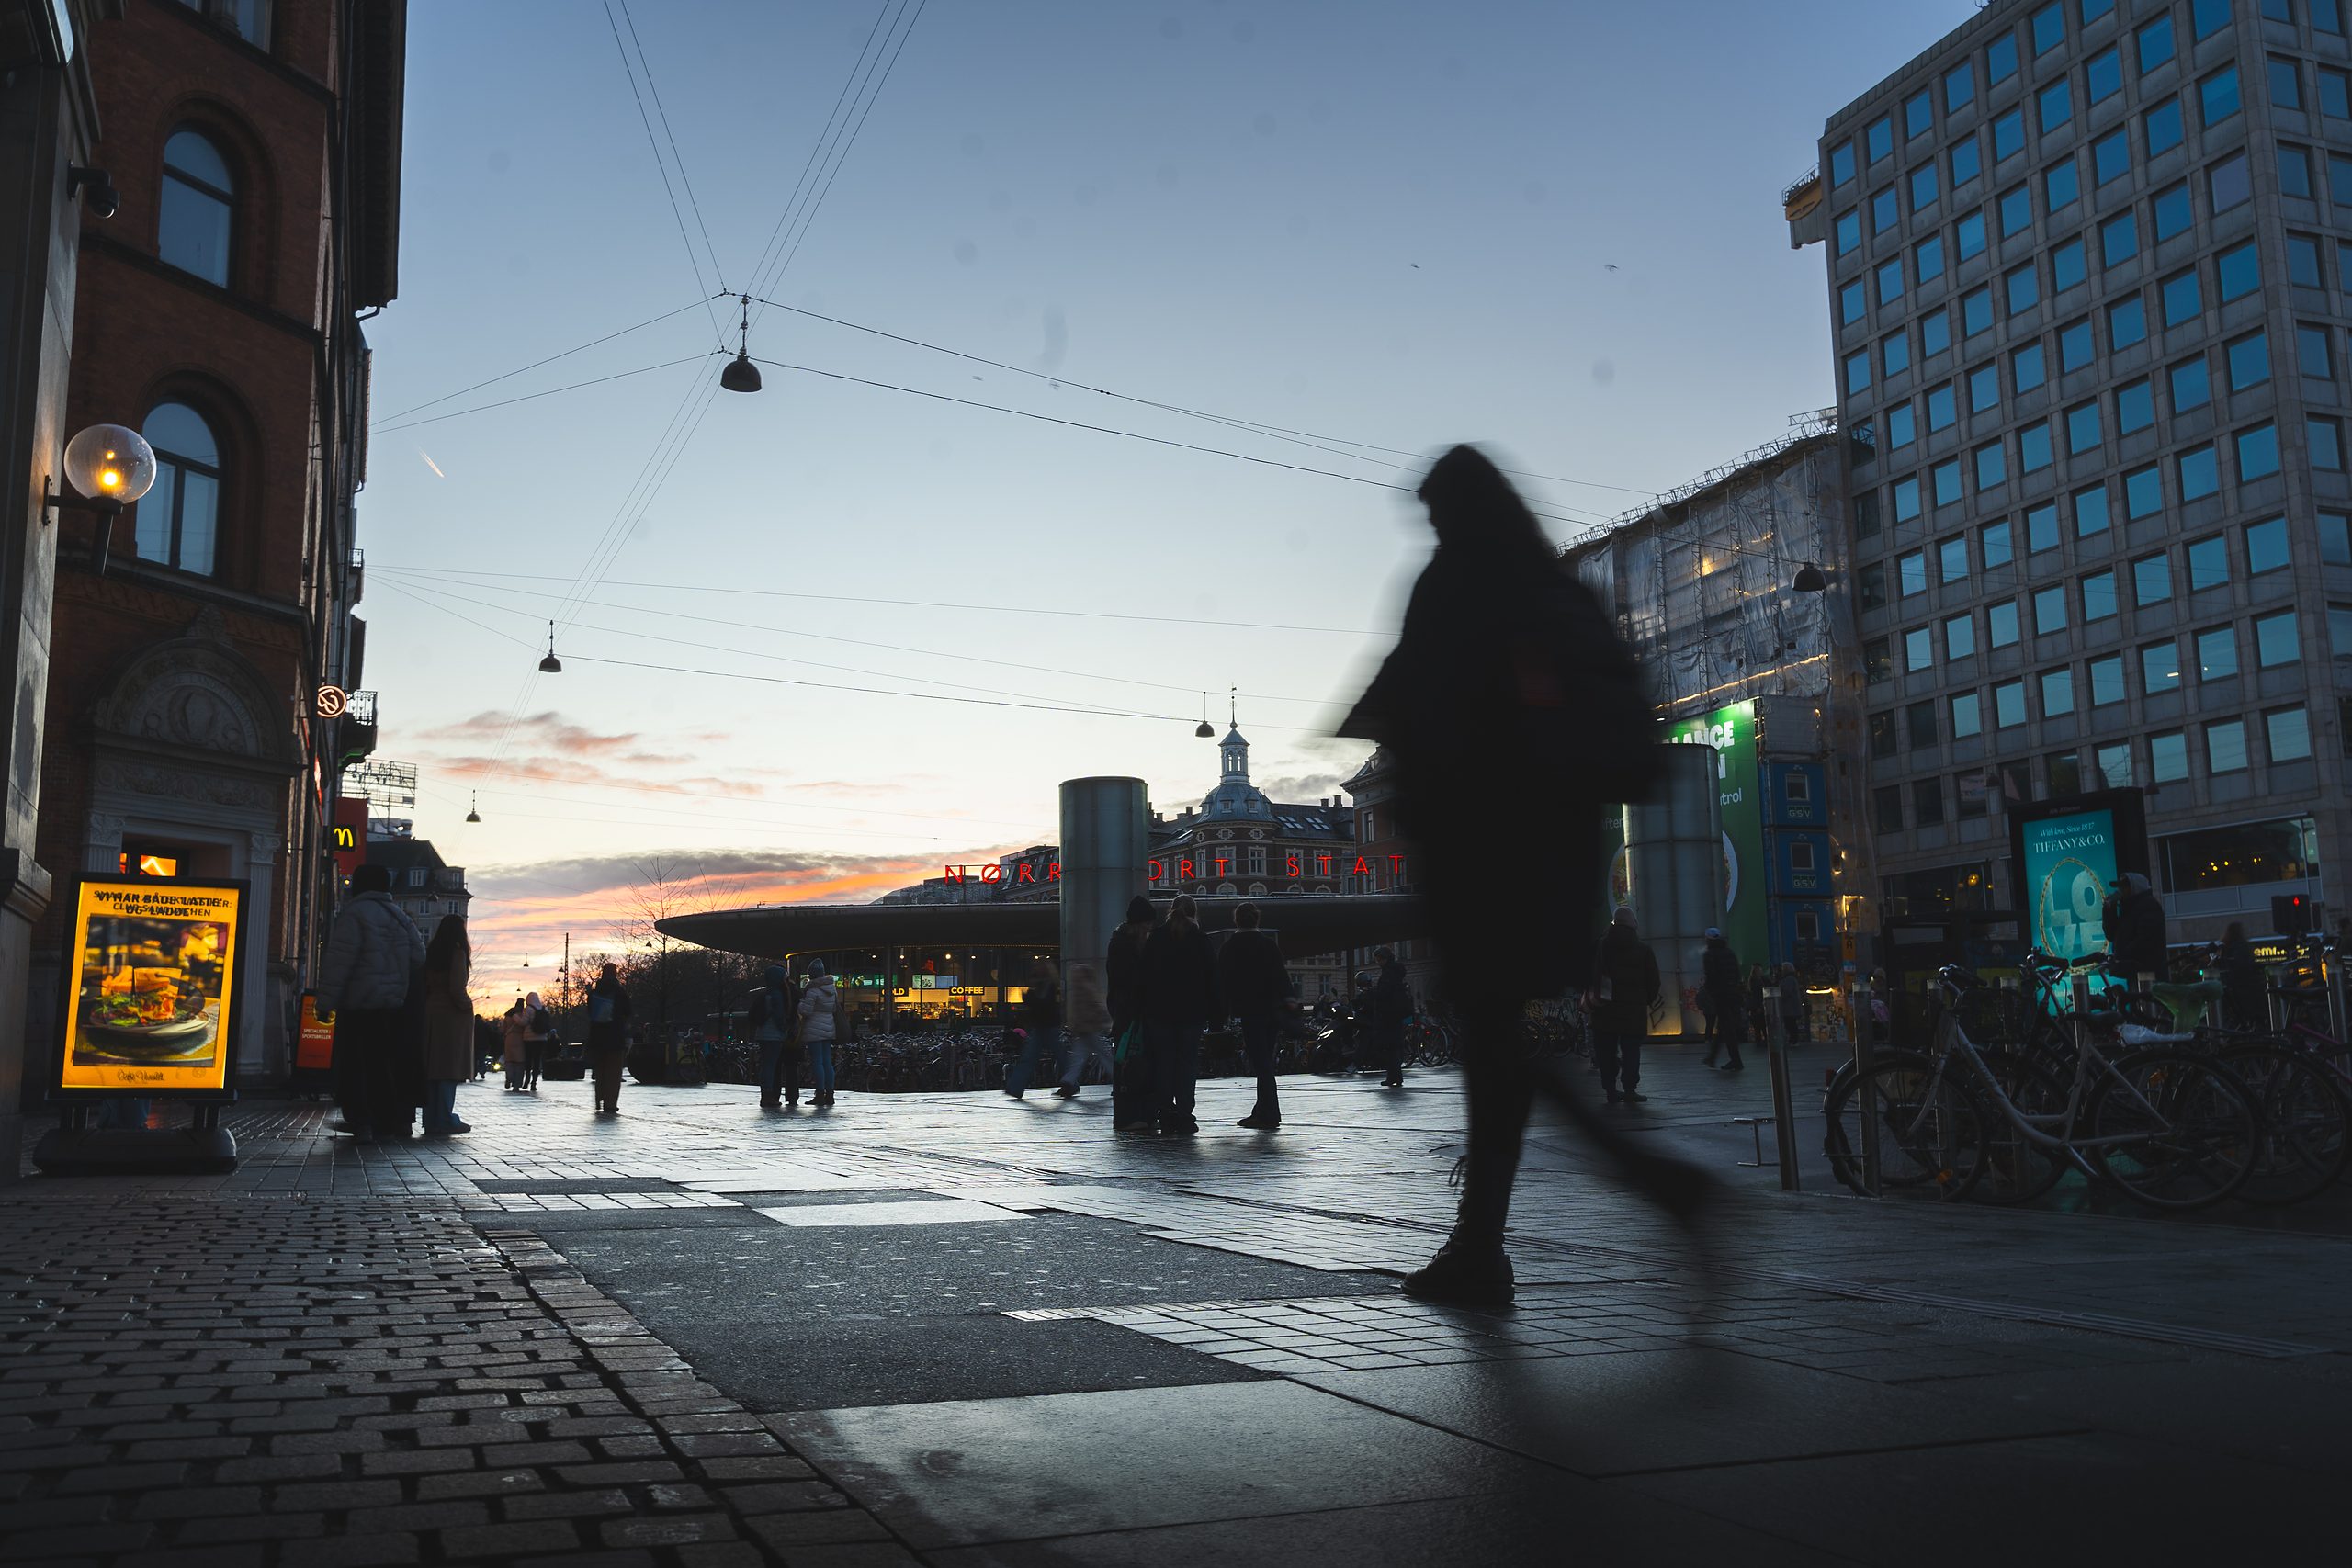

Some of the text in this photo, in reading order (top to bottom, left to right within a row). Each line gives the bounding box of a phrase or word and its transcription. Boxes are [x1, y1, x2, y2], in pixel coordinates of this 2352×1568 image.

[1789, 809, 1810, 818] GSV
[2040, 828, 2053, 837] With
[944, 855, 1403, 885] NØRRORT STAT
[1793, 879, 1815, 888] GSV
[951, 987, 984, 995] COFFEE
